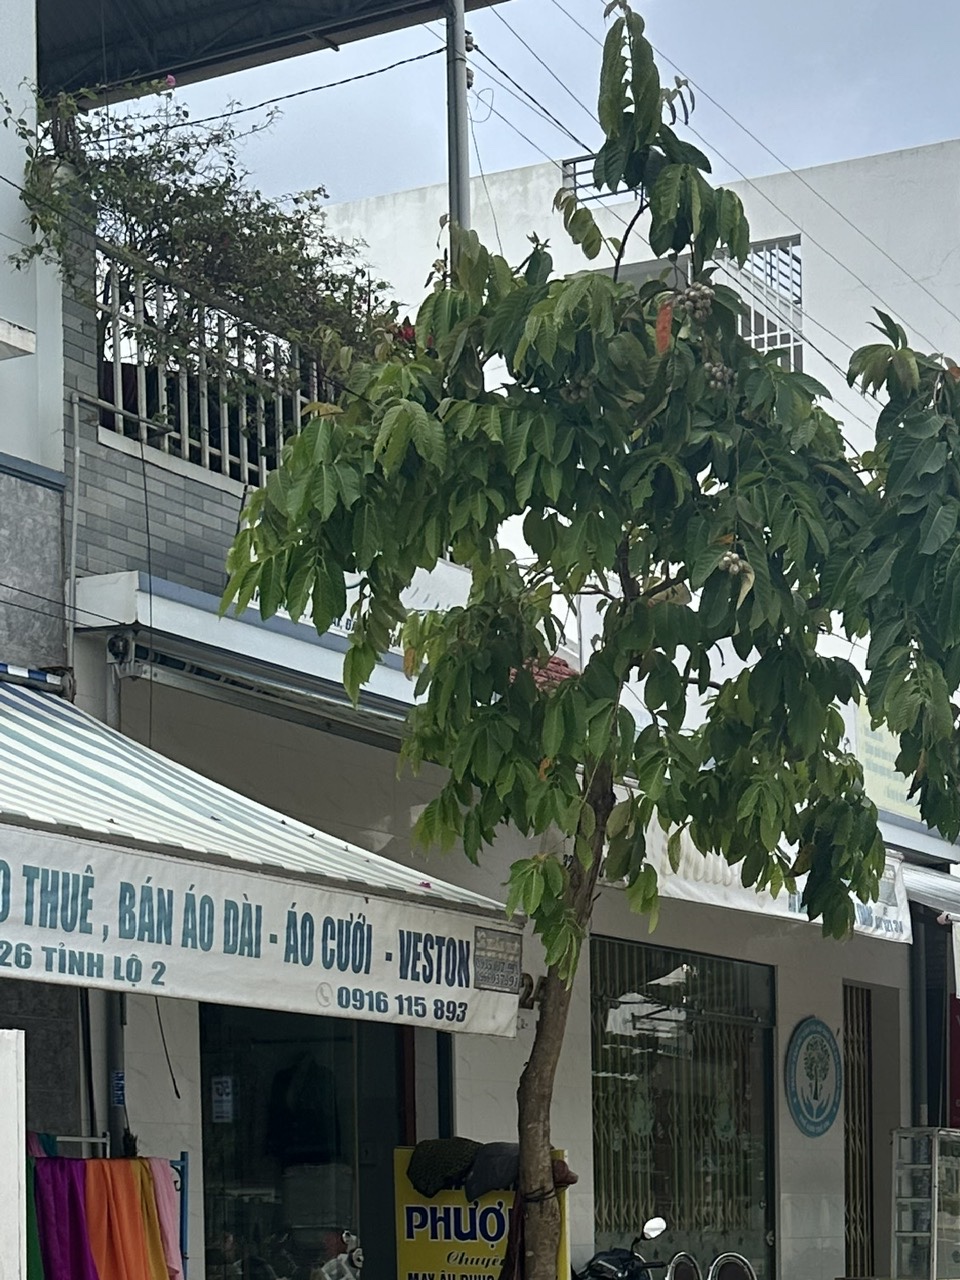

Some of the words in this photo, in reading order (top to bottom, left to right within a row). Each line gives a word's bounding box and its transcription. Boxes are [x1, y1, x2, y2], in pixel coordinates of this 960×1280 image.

[119, 877, 173, 946] BÁN
[182, 879, 214, 952] ÁO
[224, 893, 262, 959] DÀI
[284, 903, 315, 967] ÁO
[322, 906, 372, 975] CƯỚI
[399, 929, 470, 988] VESTON
[41, 941, 104, 979] TỈNH
[114, 953, 143, 988] LỘ
[151, 961, 167, 986] 2
[337, 987, 389, 1013] 0916
[397, 991, 427, 1017] 115
[433, 1001, 469, 1023] 893
[406, 1200, 513, 1248] PHƯỢ
